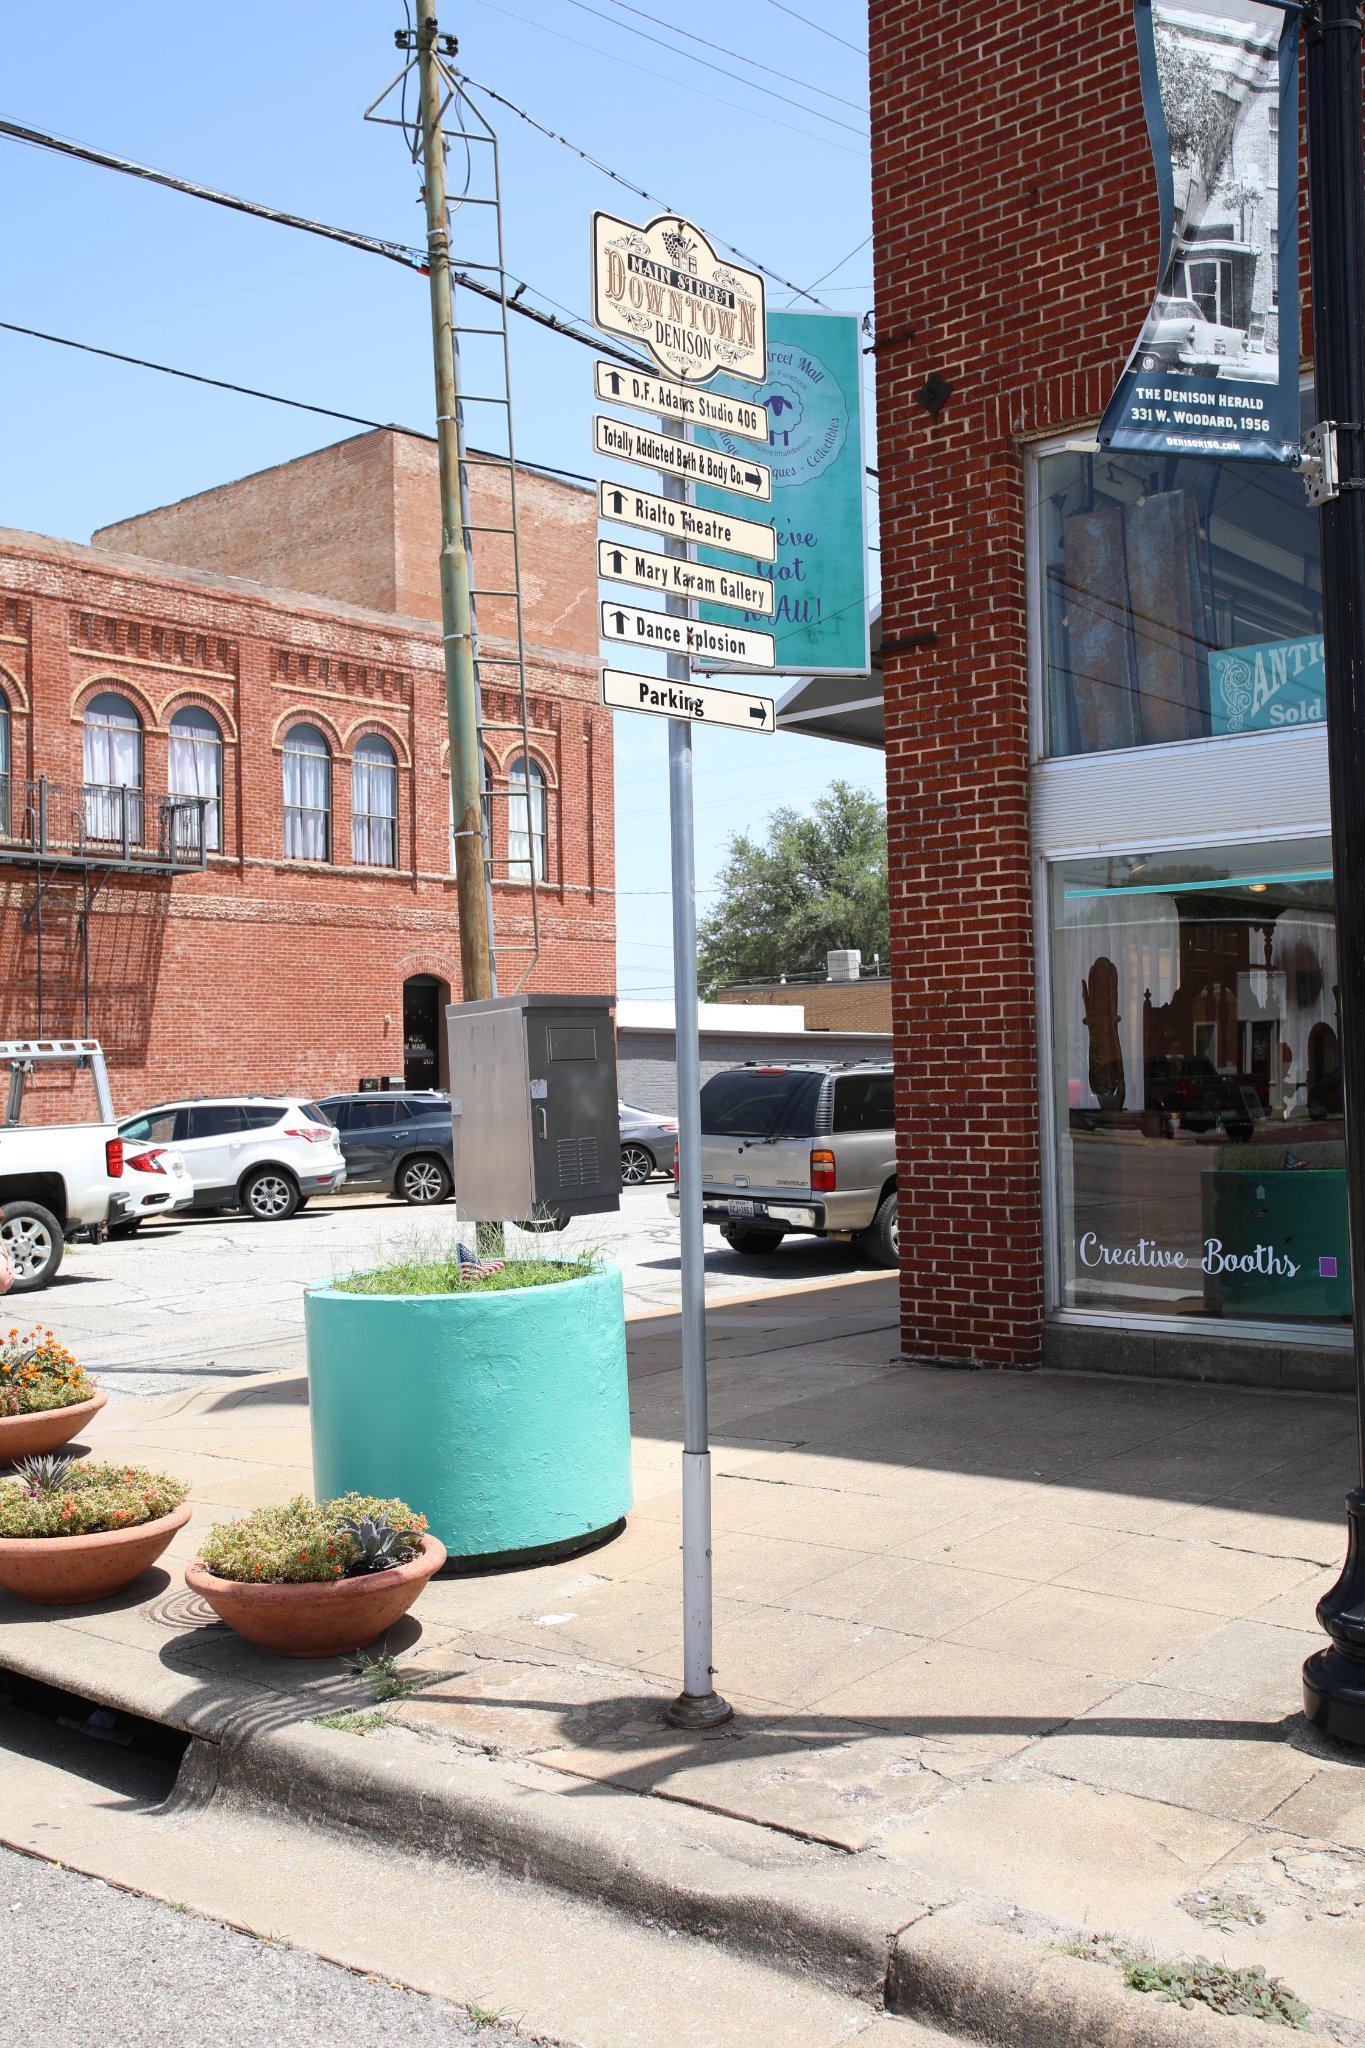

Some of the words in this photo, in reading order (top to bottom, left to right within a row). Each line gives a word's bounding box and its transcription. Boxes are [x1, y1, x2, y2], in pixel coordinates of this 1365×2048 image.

[604, 247, 756, 350] DOWNTOWN
[630, 255, 671, 286] MAIN
[677, 273, 734, 309] STREET
[656, 323, 711, 361] DENISON
[767, 350, 793, 366] treet
[798, 357, 825, 384] Mall
[632, 378, 655, 404] D.F.
[659, 384, 695, 414] Adams
[699, 396, 733, 424] Studio
[737, 407, 757, 431] 406
[1131, 407, 1153, 422] 331
[1155, 410, 1171, 424] W.
[1173, 411, 1237, 430] WOODARD,
[1240, 416, 1270, 432] 1956
[1135, 387, 1161, 401] THE
[1164, 388, 1216, 406] DENISON
[1218, 393, 1264, 411] HERALD
[603, 424, 633, 456] Totally
[636, 433, 675, 465] Addicted
[676, 444, 697, 471] Bath
[699, 455, 705, 471] &
[707, 457, 729, 486] Body
[730, 463, 744, 486] Co.
[806, 417, 840, 467] Collectibles
[635, 497, 676, 528] Rialto
[680, 510, 732, 542] Theatre
[769, 517, 818, 548] e've
[635, 556, 669, 587] Mary
[673, 565, 716, 593] Karam
[720, 577, 765, 609] Gallery
[636, 616, 681, 643] Dance
[686, 625, 746, 656] Xplosion
[639, 682, 705, 717] Parking
[1251, 641, 1325, 717] ANTI
[1269, 698, 1323, 725] Sold
[1079, 1231, 1189, 1268] Creative
[1201, 1238, 1301, 1278] Booths
